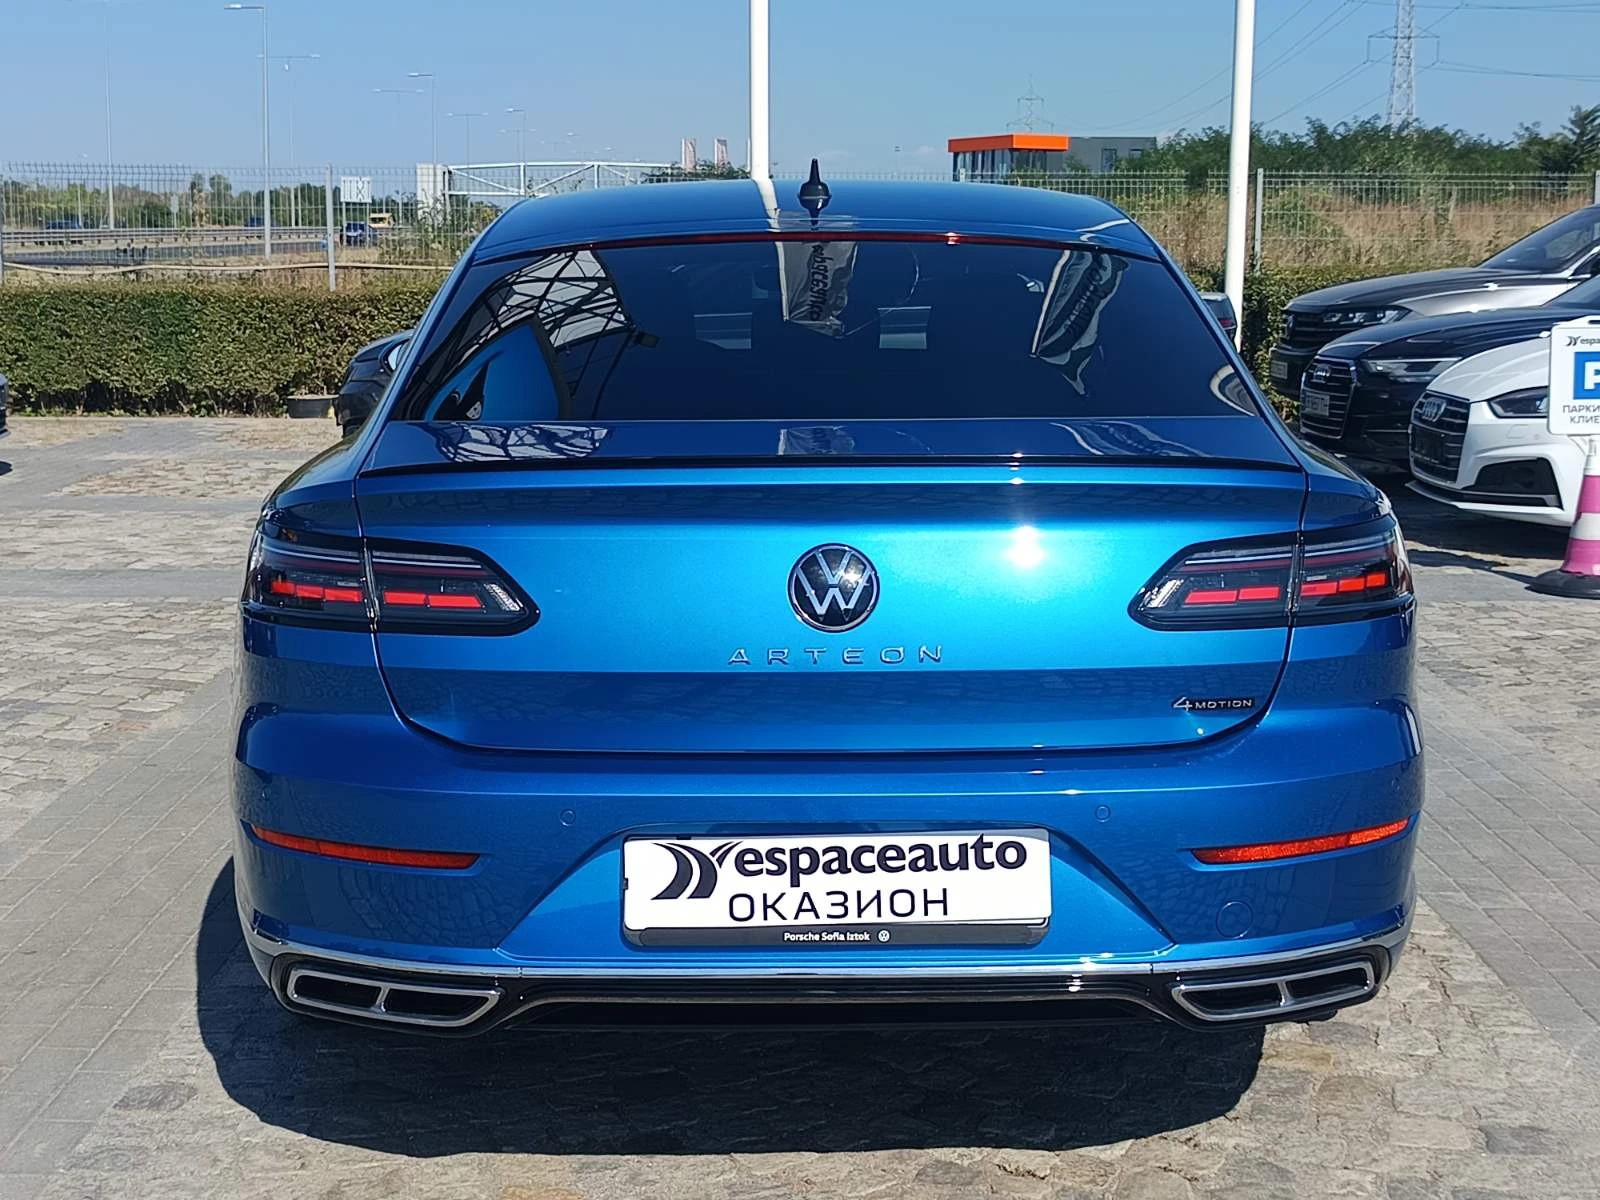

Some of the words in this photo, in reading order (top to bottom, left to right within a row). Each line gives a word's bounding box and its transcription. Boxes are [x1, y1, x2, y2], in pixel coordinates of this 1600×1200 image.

[728, 645, 944, 665] ARTEON
[1172, 696, 1253, 712] 4MOTION
[733, 833, 1028, 888] espaceauto
[728, 888, 949, 922] ОКАЗИОН
[783, 931, 820, 942] Porsche
[821, 931, 846, 942] Sofia
[846, 931, 871, 942] Iztok
